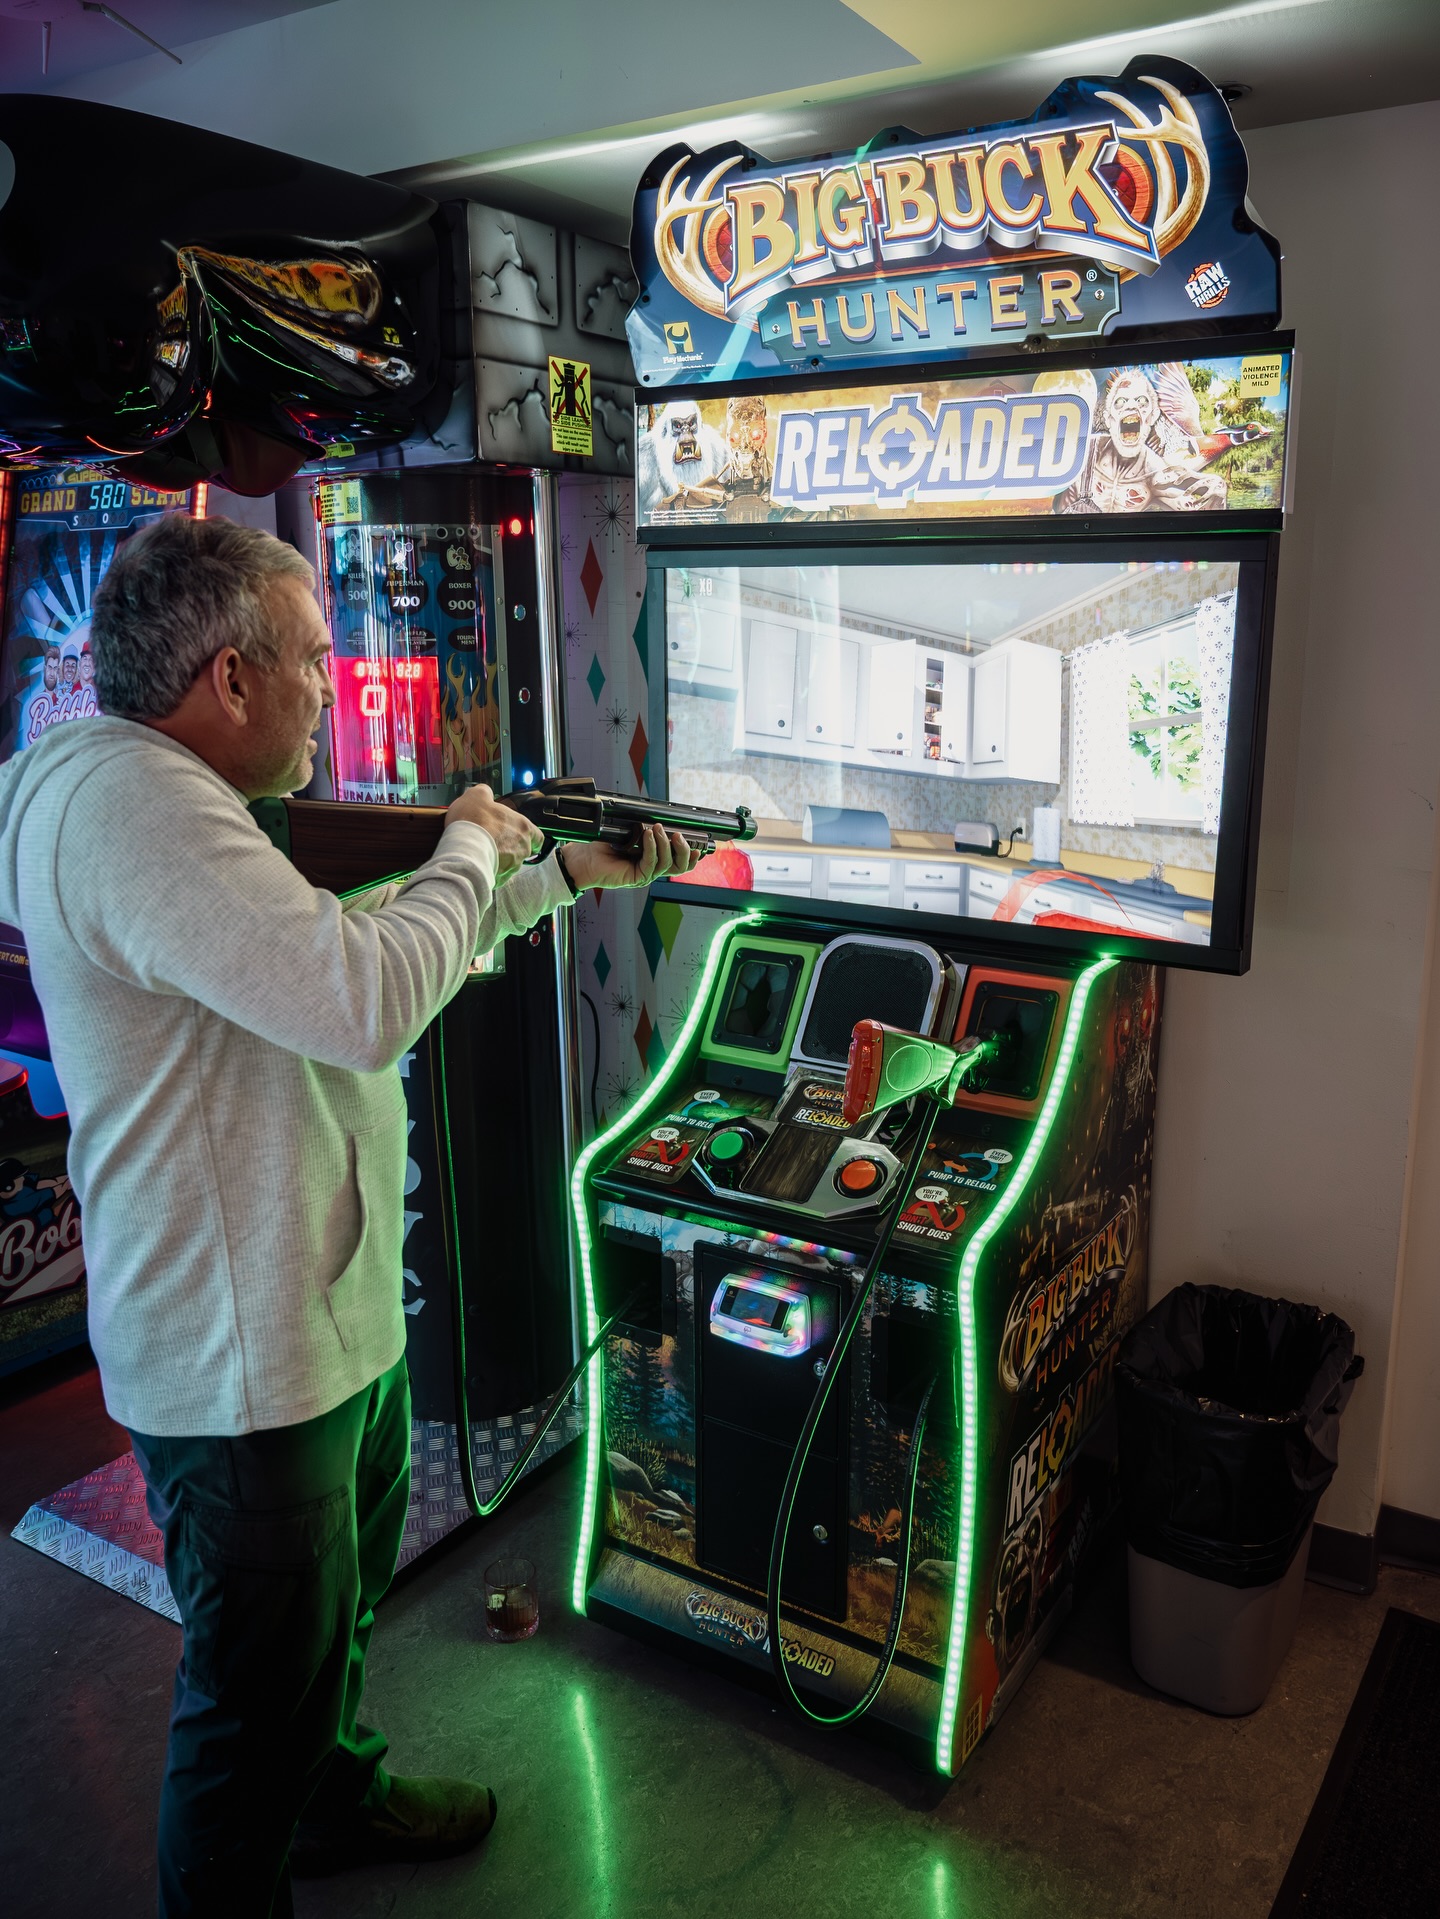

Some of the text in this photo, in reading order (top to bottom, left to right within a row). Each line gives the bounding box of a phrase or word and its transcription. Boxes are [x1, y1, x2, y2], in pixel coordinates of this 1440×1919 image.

[729, 128, 1150, 301] BIG BUCK
[1184, 262, 1225, 300] RAW
[1192, 276, 1231, 308] THRILLS
[787, 270, 1083, 347] HUNTER
[1242, 364, 1280, 373] ANIMATED
[1242, 372, 1279, 380] VIOLENCE
[779, 403, 1081, 493] RELOADED
[20, 489, 76, 513] GRAND
[89, 483, 126, 511] 580
[448, 582, 472, 590] BOXER
[392, 596, 421, 608] 700
[448, 600, 476, 611] 900
[665, 1113, 687, 1123] PUMP
[795, 1109, 851, 1129] RELOADED
[627, 1157, 673, 1173] SHOOT DOES
[927, 1170, 997, 1191] PUMP TO RELOAD
[922, 1188, 943, 1196] YOU'RE
[896, 1221, 952, 1241] SHOOT DOES
[1023, 1216, 1125, 1370] BIG BUCK
[1036, 1287, 1111, 1393] HUNTER
[695, 1600, 757, 1640] BIG BUCK
[699, 1620, 745, 1646] HUNTER
